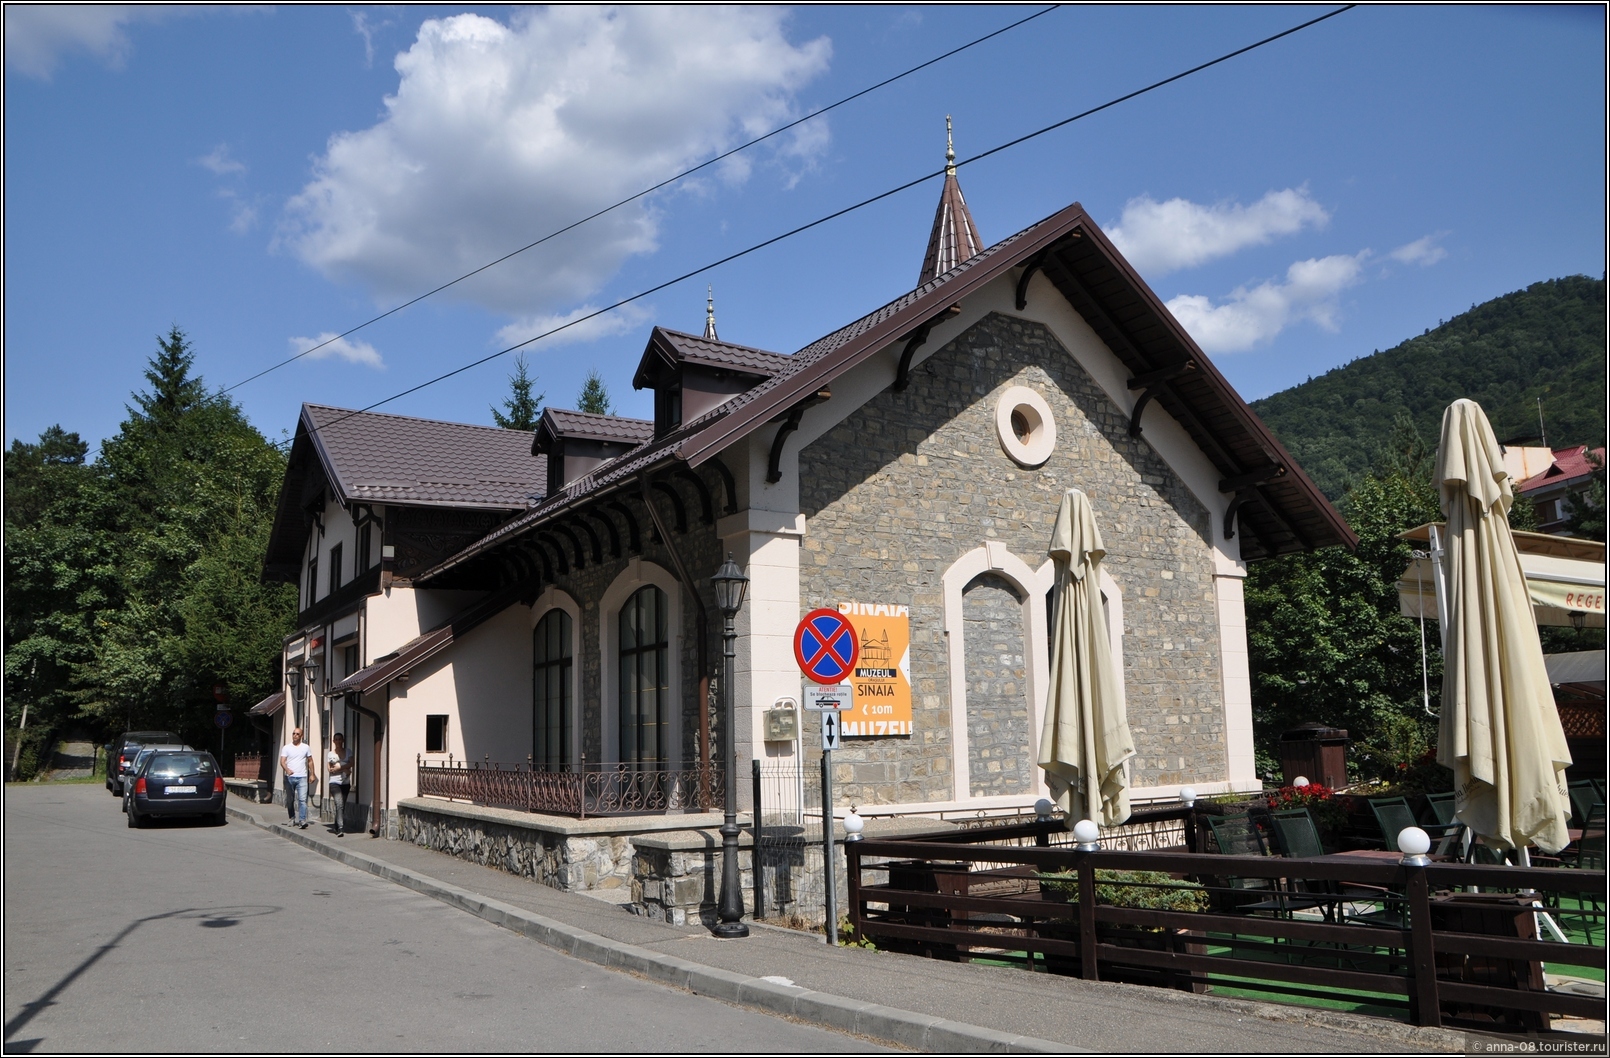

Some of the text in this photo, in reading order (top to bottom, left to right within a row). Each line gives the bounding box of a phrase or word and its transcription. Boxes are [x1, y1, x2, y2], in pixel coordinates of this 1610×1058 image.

[860, 669, 892, 678] MUZEUL
[857, 684, 895, 697] SINAIA
[871, 705, 893, 715] 10m
